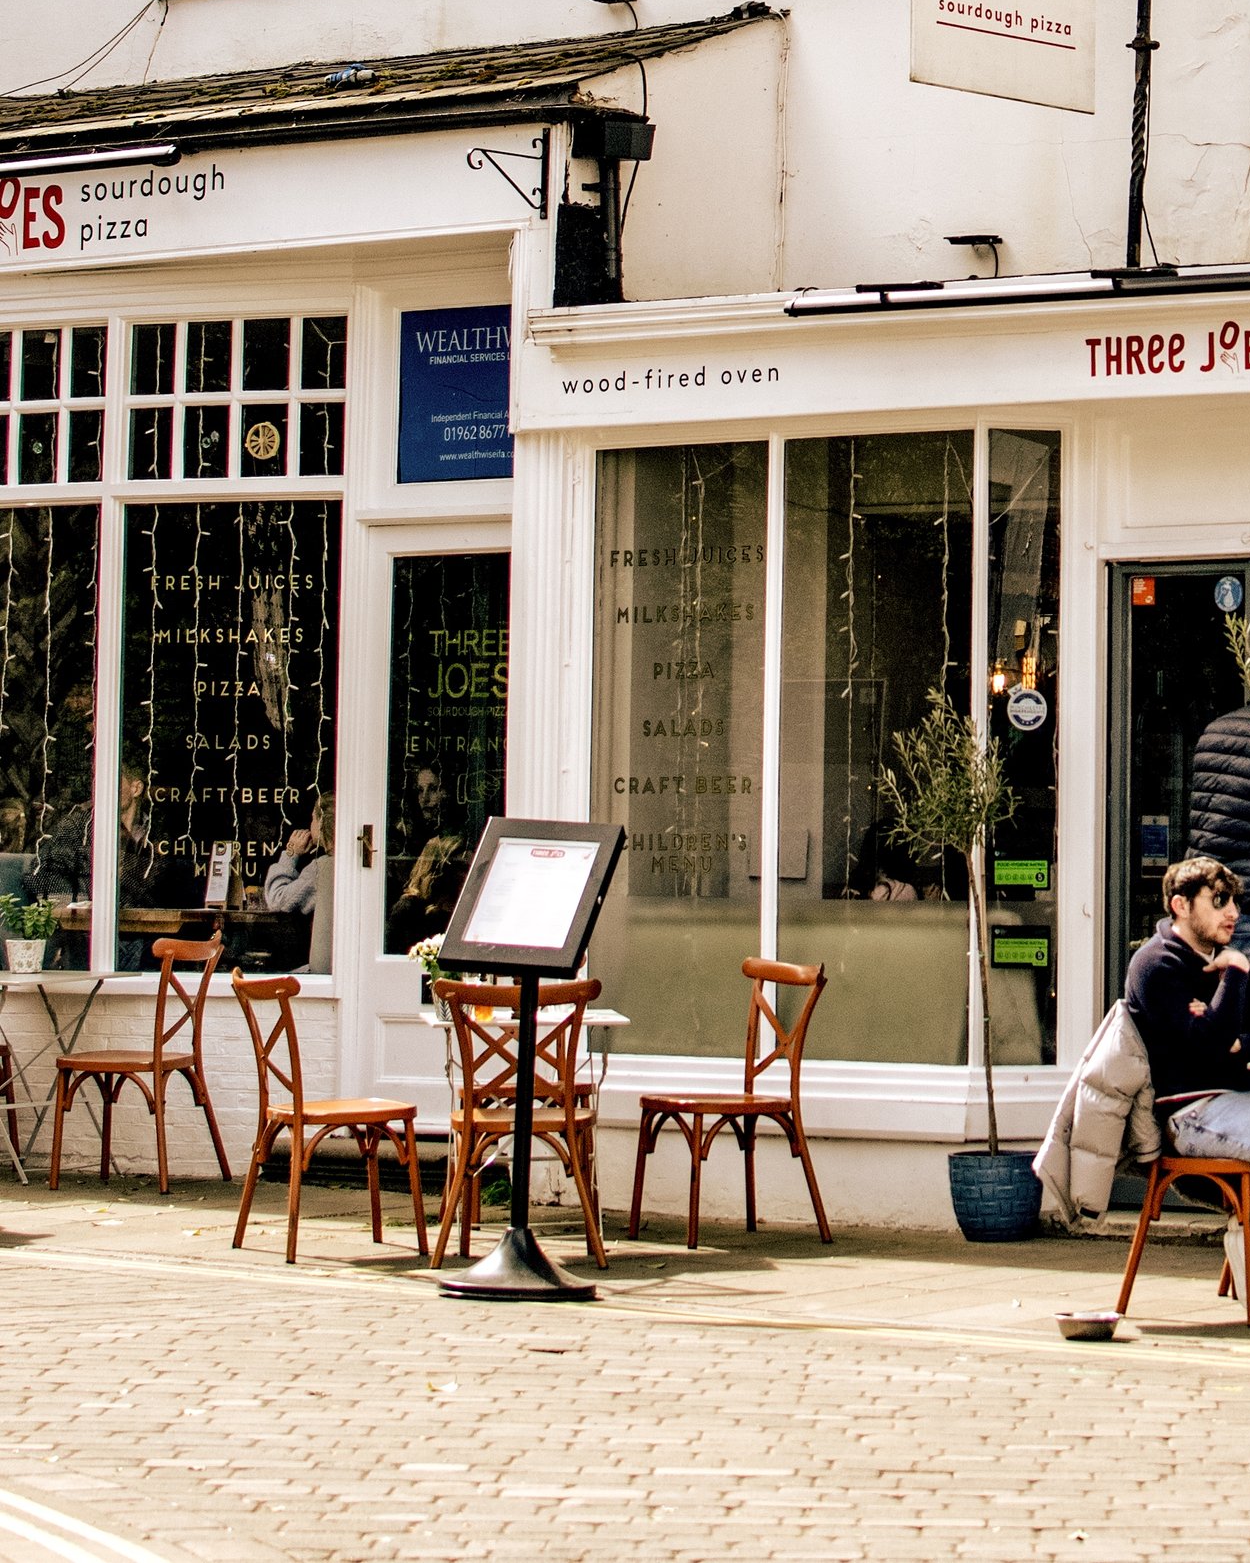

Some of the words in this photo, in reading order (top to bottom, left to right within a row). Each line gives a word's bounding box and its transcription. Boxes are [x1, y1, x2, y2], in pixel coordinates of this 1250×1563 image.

[1030, 13, 1072, 36] pizza
[81, 163, 224, 202] sourdough
[81, 215, 148, 250] pizza
[429, 354, 468, 365] FINANCIAL
[470, 352, 506, 362] SERVICES
[1085, 333, 1185, 377] THRee
[562, 366, 706, 394] wood-fired
[721, 367, 779, 385] oven
[431, 413, 471, 424] Independent
[472, 410, 503, 420] Financial
[444, 425, 477, 441] 01962
[610, 549, 677, 568] FRESH
[689, 545, 764, 564] JUICES
[150, 575, 221, 591] FRESH
[234, 574, 313, 590] JUICES
[617, 604, 755, 624] MILKSHAKES
[158, 627, 304, 643] MILKSHAKES
[429, 630, 509, 657] THREE
[653, 661, 715, 680] PIZZA
[197, 681, 261, 697] PIZZA
[428, 663, 509, 699] JOES
[642, 719, 725, 737] SALADS
[185, 734, 271, 750] SALADS
[613, 776, 690, 795] CRAFT
[695, 776, 753, 795] BEER
[155, 788, 227, 804] CRAFT
[241, 788, 300, 804] BEER
[158, 841, 295, 858] CHILDREN'S
[194, 861, 257, 877] MENU
[651, 855, 713, 875] MENU
